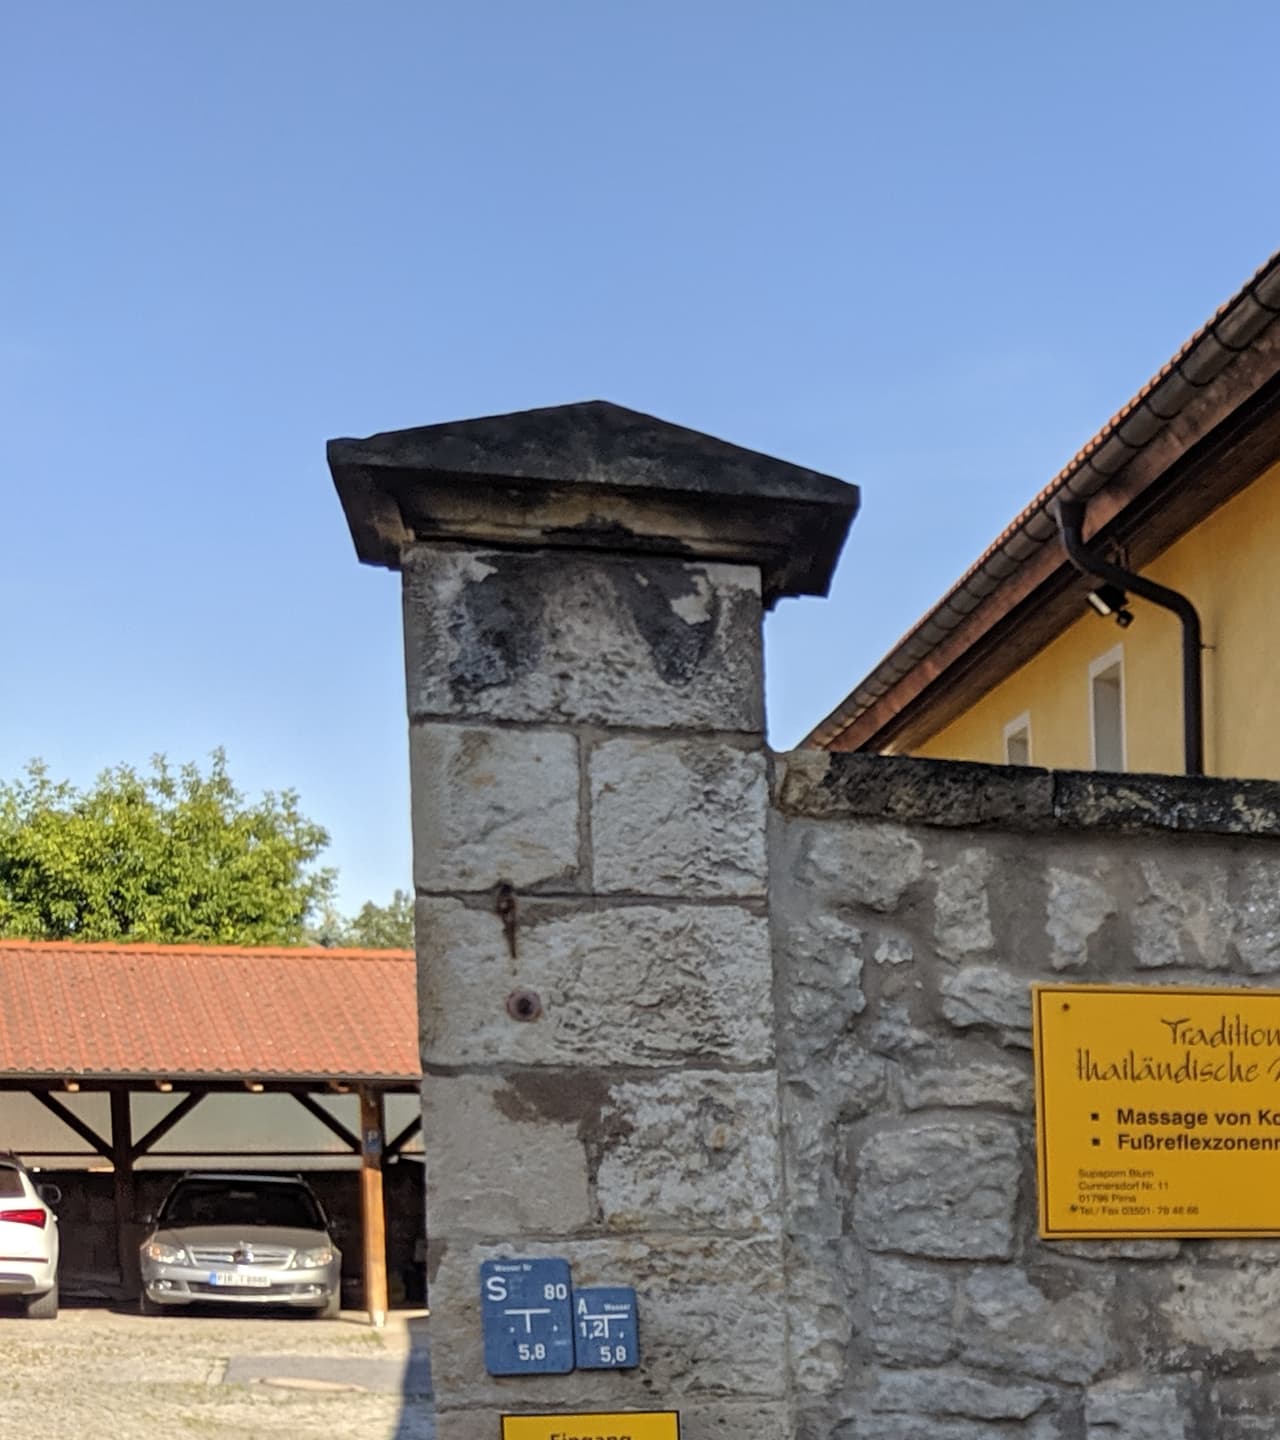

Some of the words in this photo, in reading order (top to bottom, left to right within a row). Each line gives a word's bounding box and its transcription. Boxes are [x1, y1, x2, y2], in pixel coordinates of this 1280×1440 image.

[1076, 1047, 1260, 1085] thailändische
[1116, 1108, 1208, 1128] Massage
[1215, 1111, 1252, 1127] von
[1158, 1181, 1169, 1191] 11
[486, 1276, 508, 1301] S
[543, 1283, 568, 1300] 80
[578, 1298, 588, 1315] A
[604, 1303, 631, 1312] Wasser
